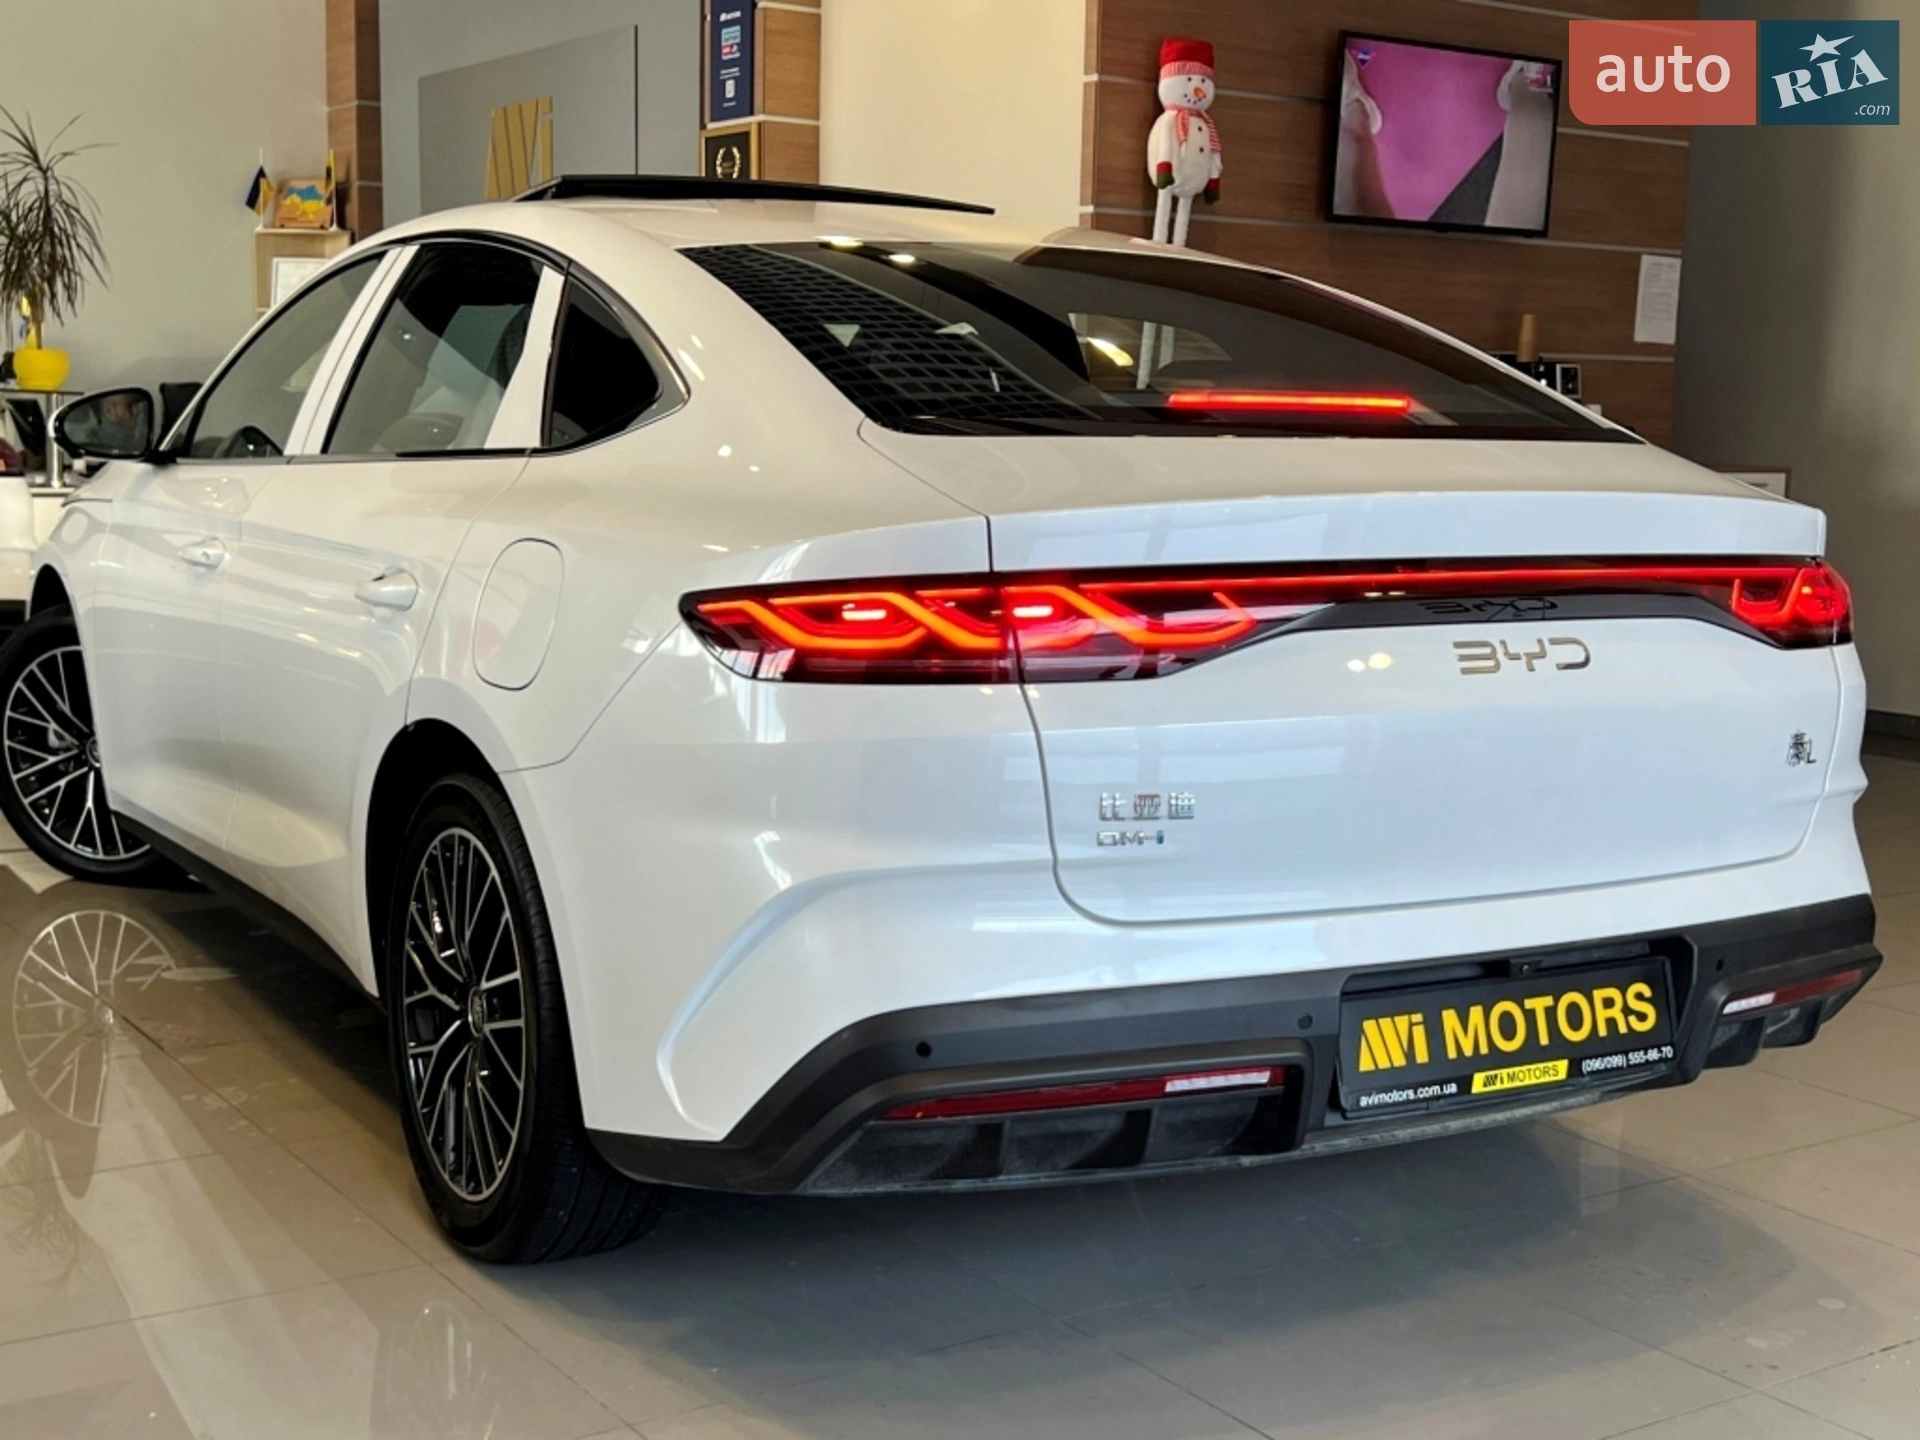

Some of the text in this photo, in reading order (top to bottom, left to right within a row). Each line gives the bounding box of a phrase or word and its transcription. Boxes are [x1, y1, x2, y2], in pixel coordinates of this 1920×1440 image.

[1453, 636, 1591, 675] BYD
[1099, 792, 1196, 821] 比亚迪
[1441, 982, 1658, 1060] MOTORS
[1507, 1064, 1560, 1085] MOTORS
[1582, 1053, 1627, 1075] (096/099)
[1359, 1082, 1458, 1107] avimotors.com.ua
